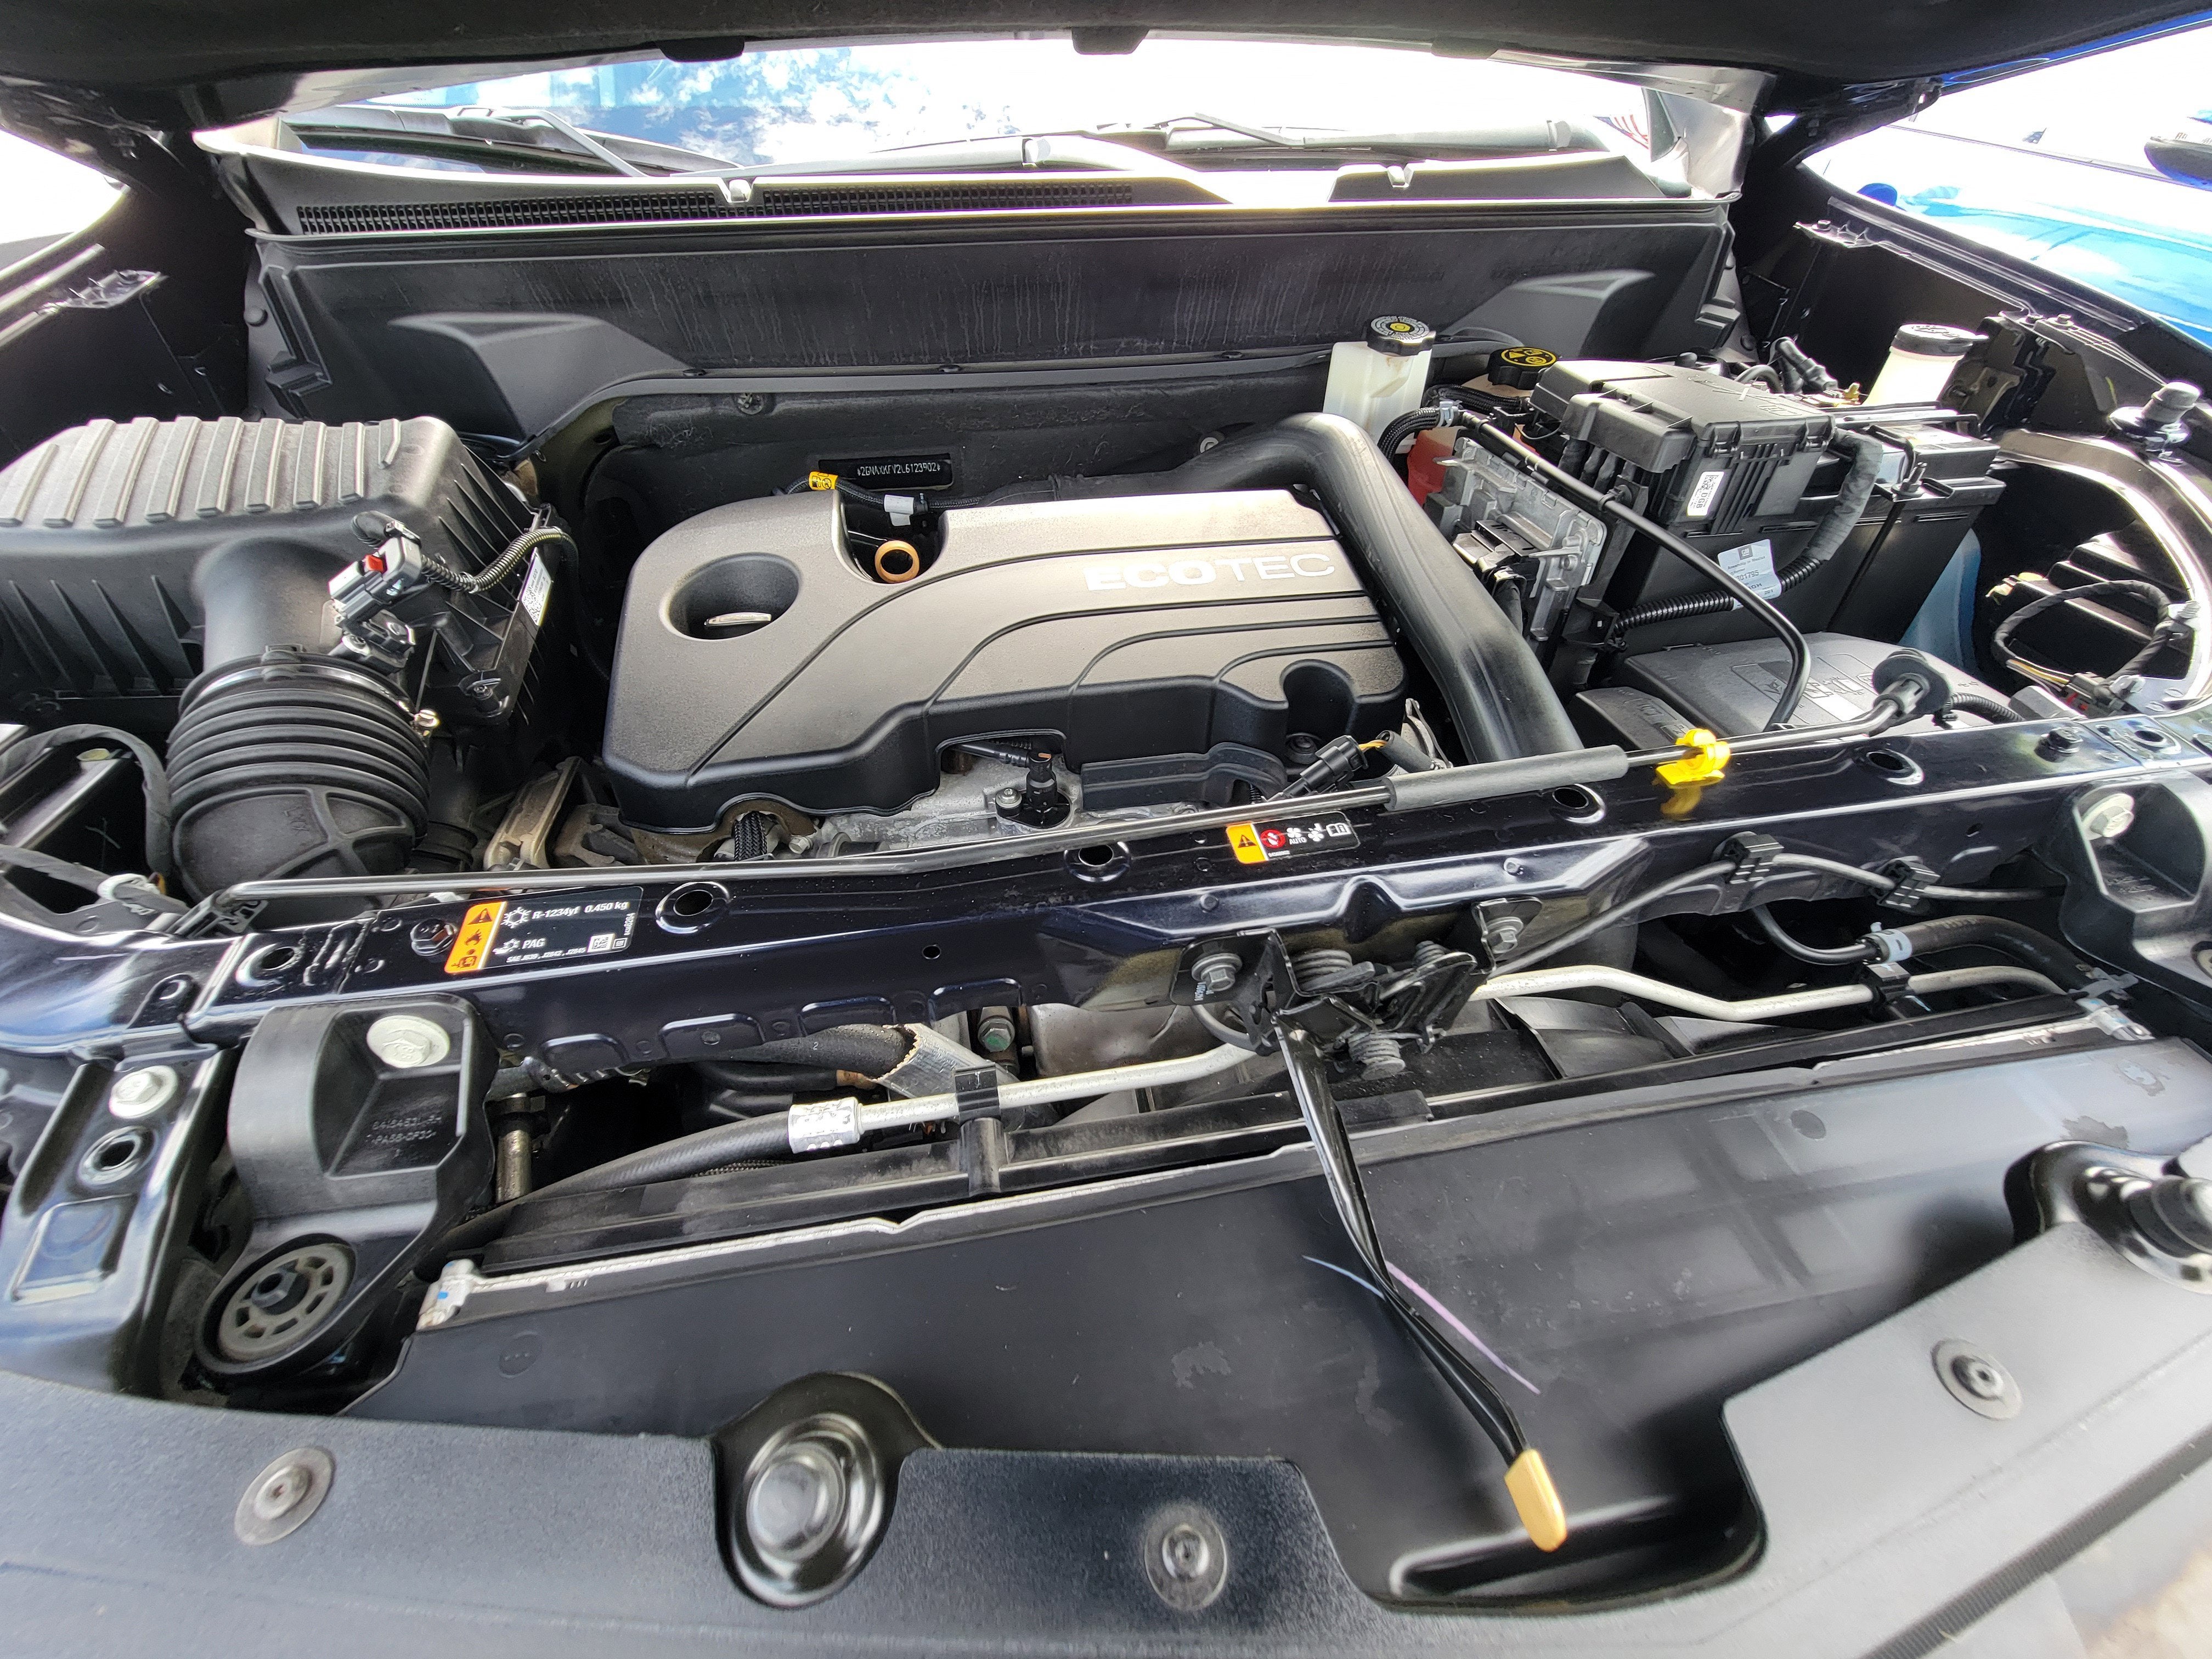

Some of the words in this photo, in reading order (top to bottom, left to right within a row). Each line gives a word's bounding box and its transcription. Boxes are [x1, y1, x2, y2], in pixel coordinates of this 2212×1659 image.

[1083, 553, 1335, 591] ECOTEC
[1289, 837, 1307, 845] AUTO
[532, 906, 581, 919] R-1234yf
[584, 902, 614, 913] 0.450
[614, 901, 629, 910] kg
[522, 938, 546, 949] PAG
[813, 1041, 819, 1050] 2
